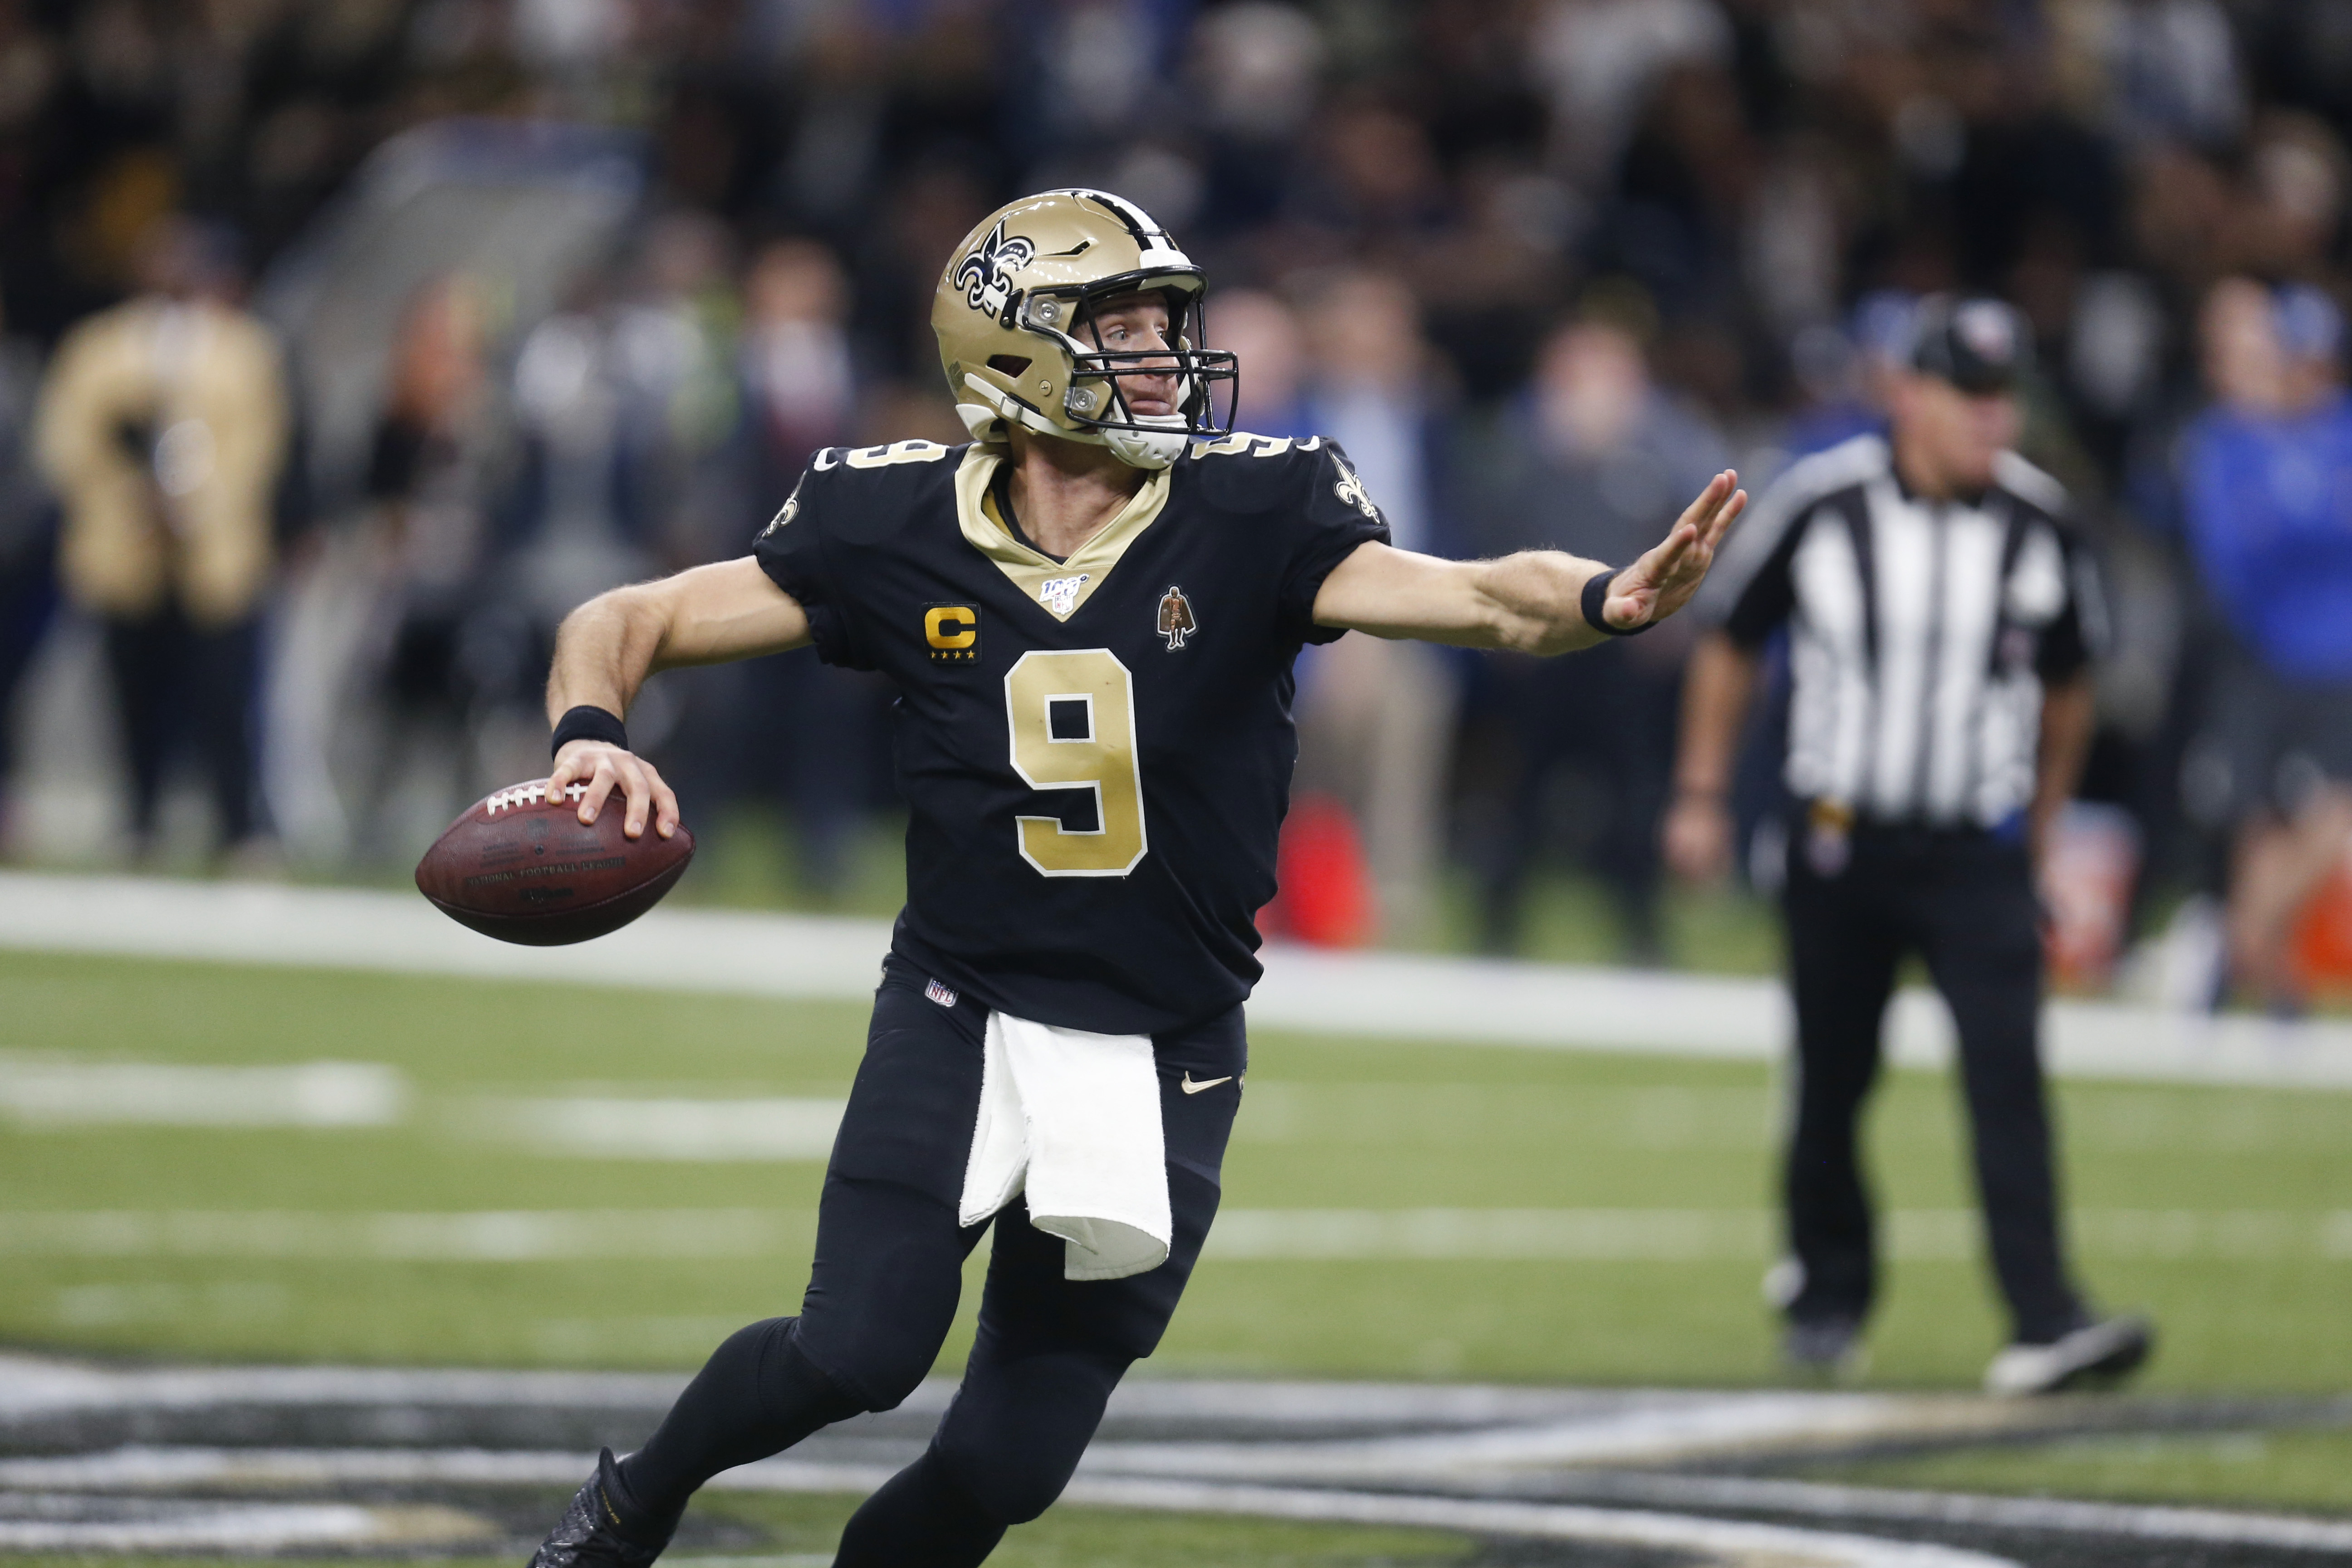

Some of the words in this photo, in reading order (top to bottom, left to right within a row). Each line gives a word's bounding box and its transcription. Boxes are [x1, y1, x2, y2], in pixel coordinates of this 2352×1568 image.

[925, 607, 976, 649] C
[1004, 648, 1148, 877] 9
[464, 871, 516, 886] NATIONAL
[520, 863, 578, 878] FOOTBALL
[581, 857, 626, 871] LEAGUE
[930, 985, 951, 1002] NFL
